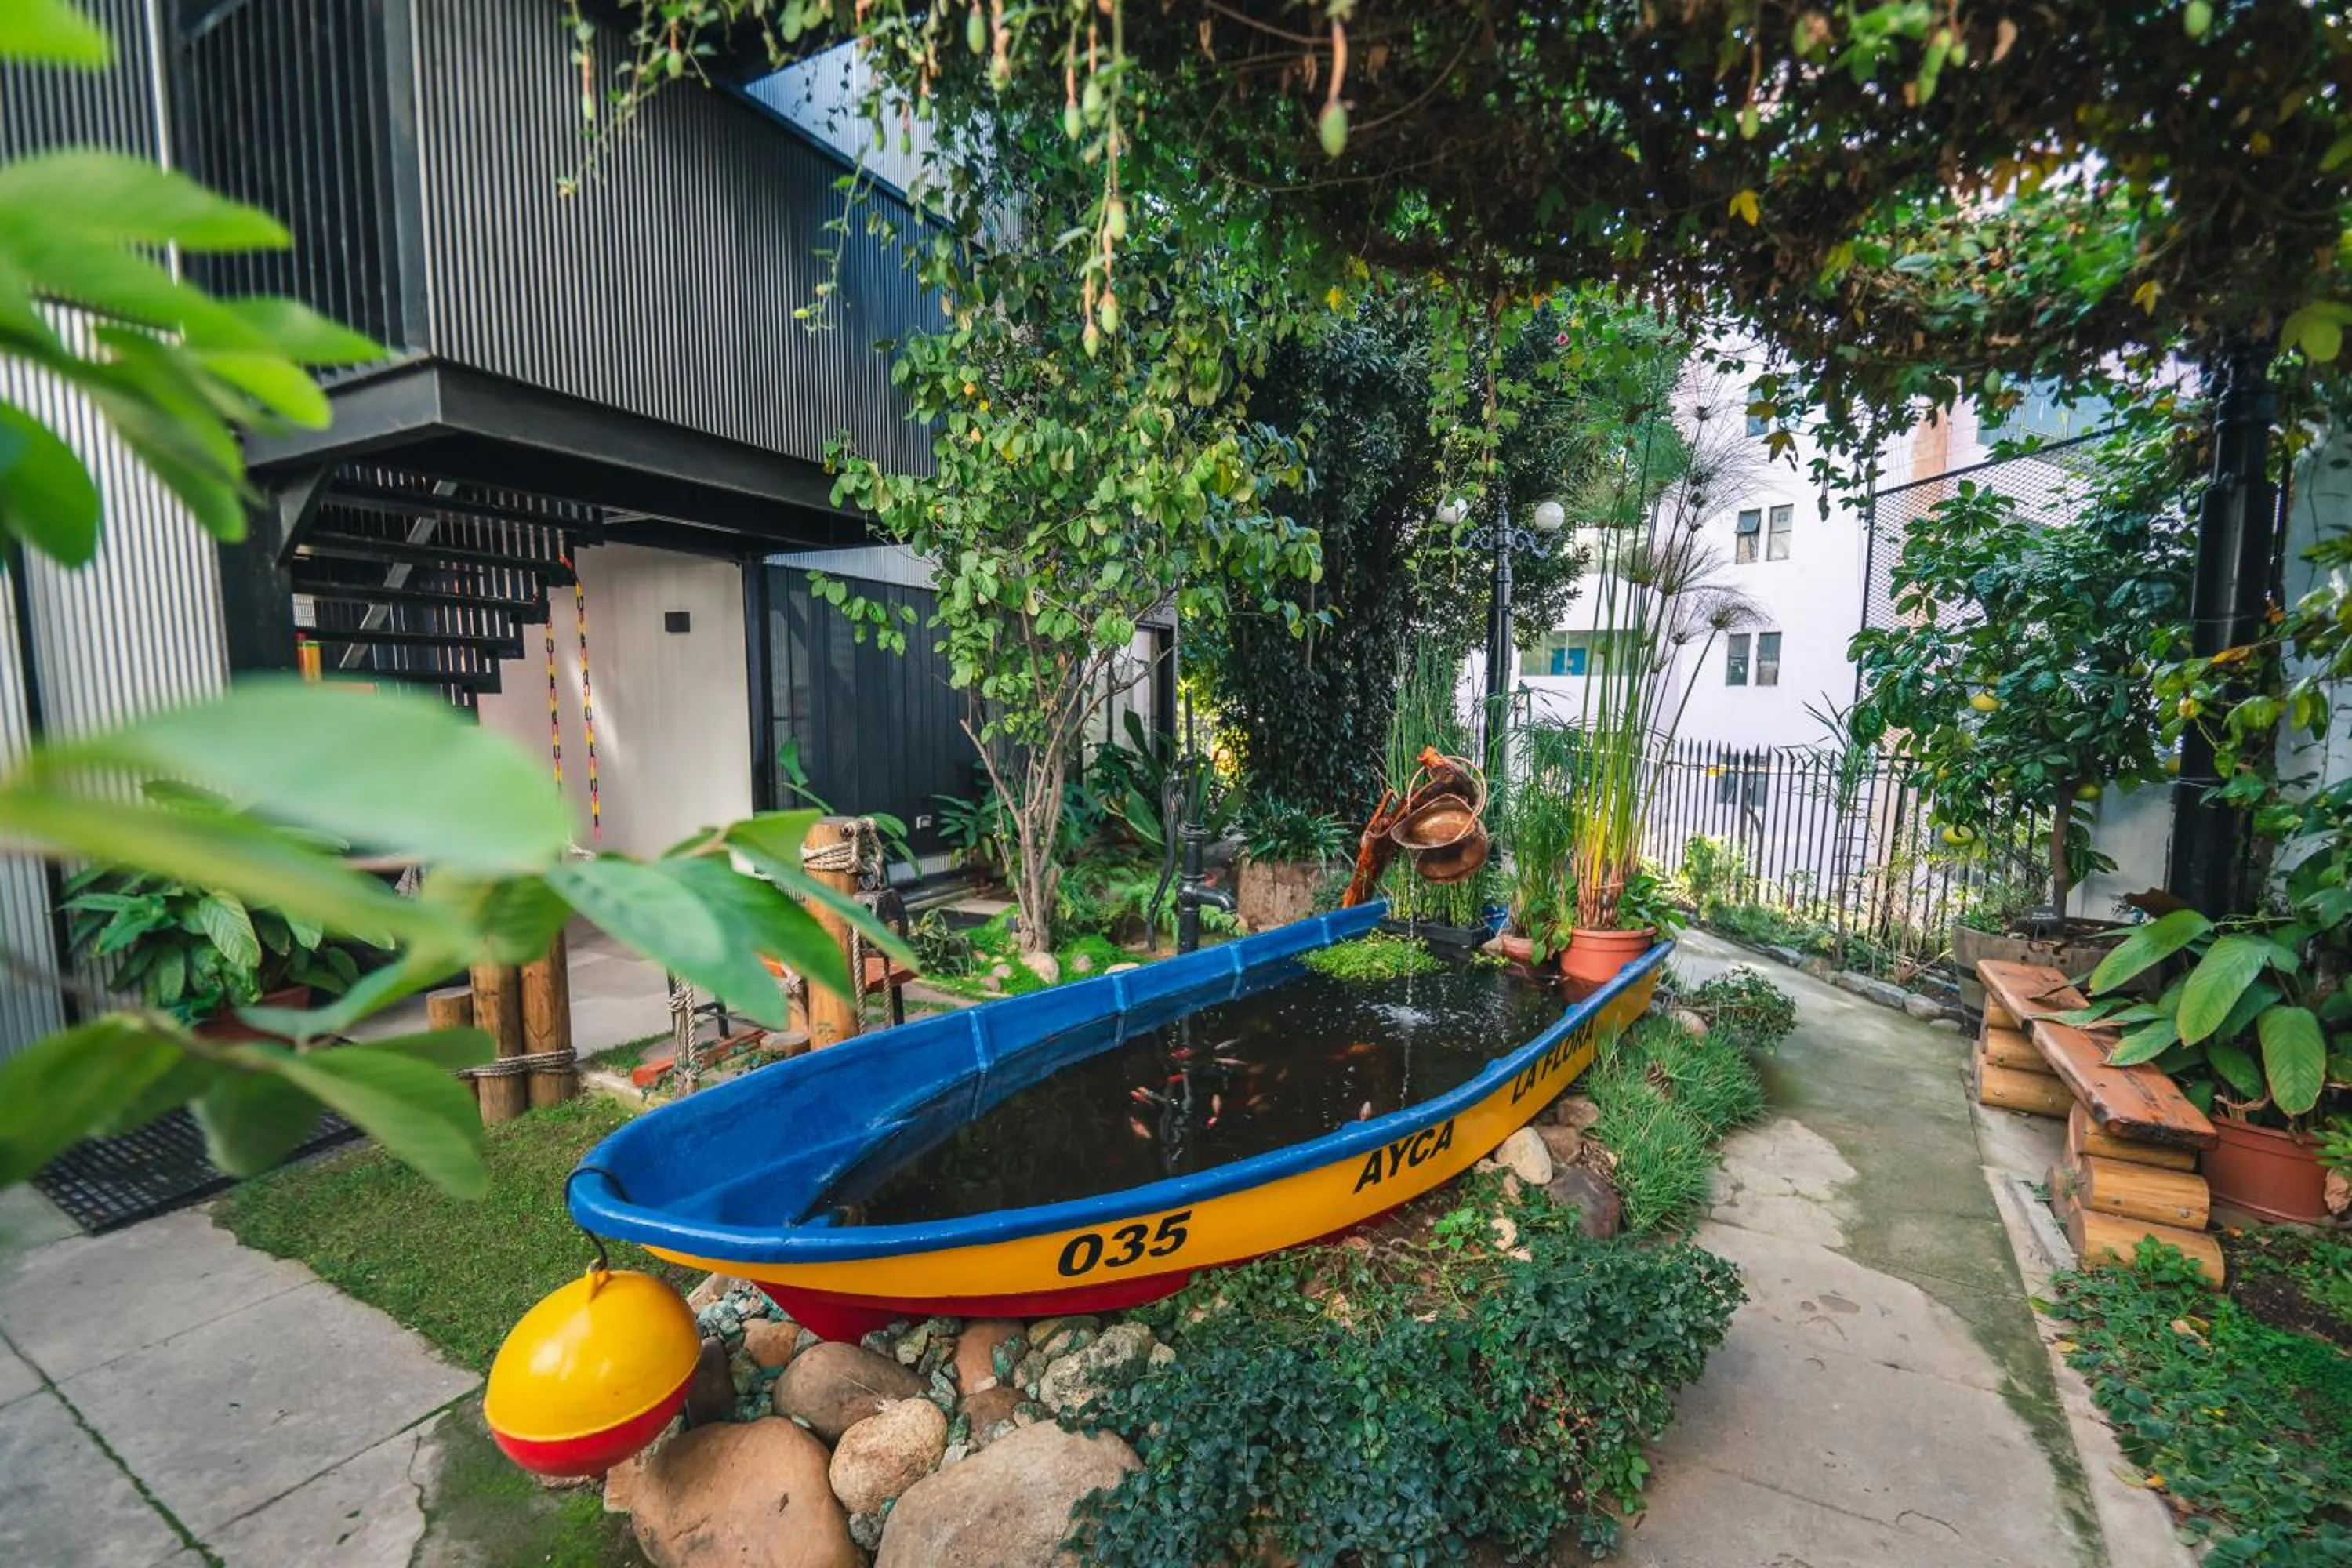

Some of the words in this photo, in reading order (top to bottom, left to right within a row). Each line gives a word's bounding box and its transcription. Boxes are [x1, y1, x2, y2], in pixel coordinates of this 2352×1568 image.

[1511, 1062, 1537, 1105] LA
[1541, 1017, 1595, 1080] FLORA
[1353, 1119, 1455, 1194] AYCA
[1058, 1210, 1192, 1277] 035
